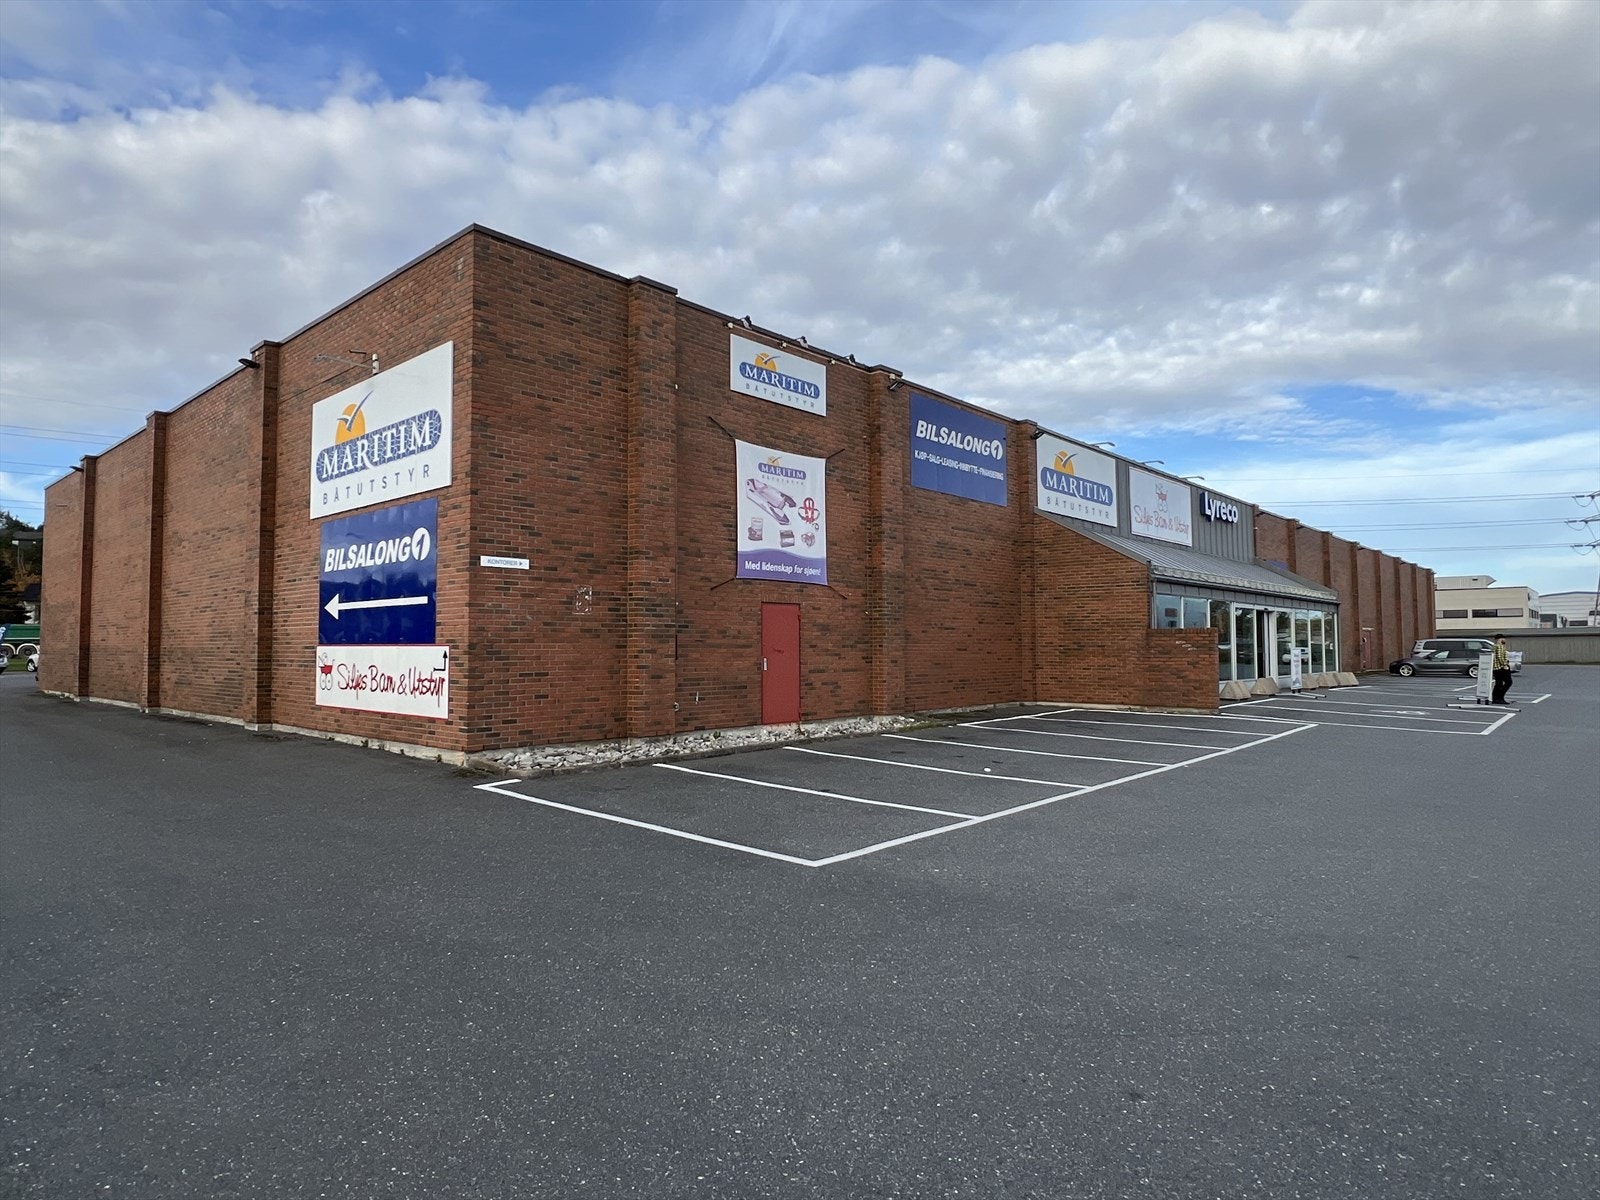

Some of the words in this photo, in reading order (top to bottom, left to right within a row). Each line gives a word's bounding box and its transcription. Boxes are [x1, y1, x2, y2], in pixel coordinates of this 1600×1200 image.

[745, 364, 816, 397] MARITIM
[321, 416, 432, 479] MARITIM
[761, 464, 804, 479] MARITIM
[1046, 470, 1110, 504] MARITIM
[1203, 491, 1239, 524] Lyreco
[487, 558, 518, 566] KONTORER
[745, 560, 760, 570] Med
[761, 561, 793, 574] lidenskap
[794, 564, 803, 574] for
[397, 674, 407, 696] &
